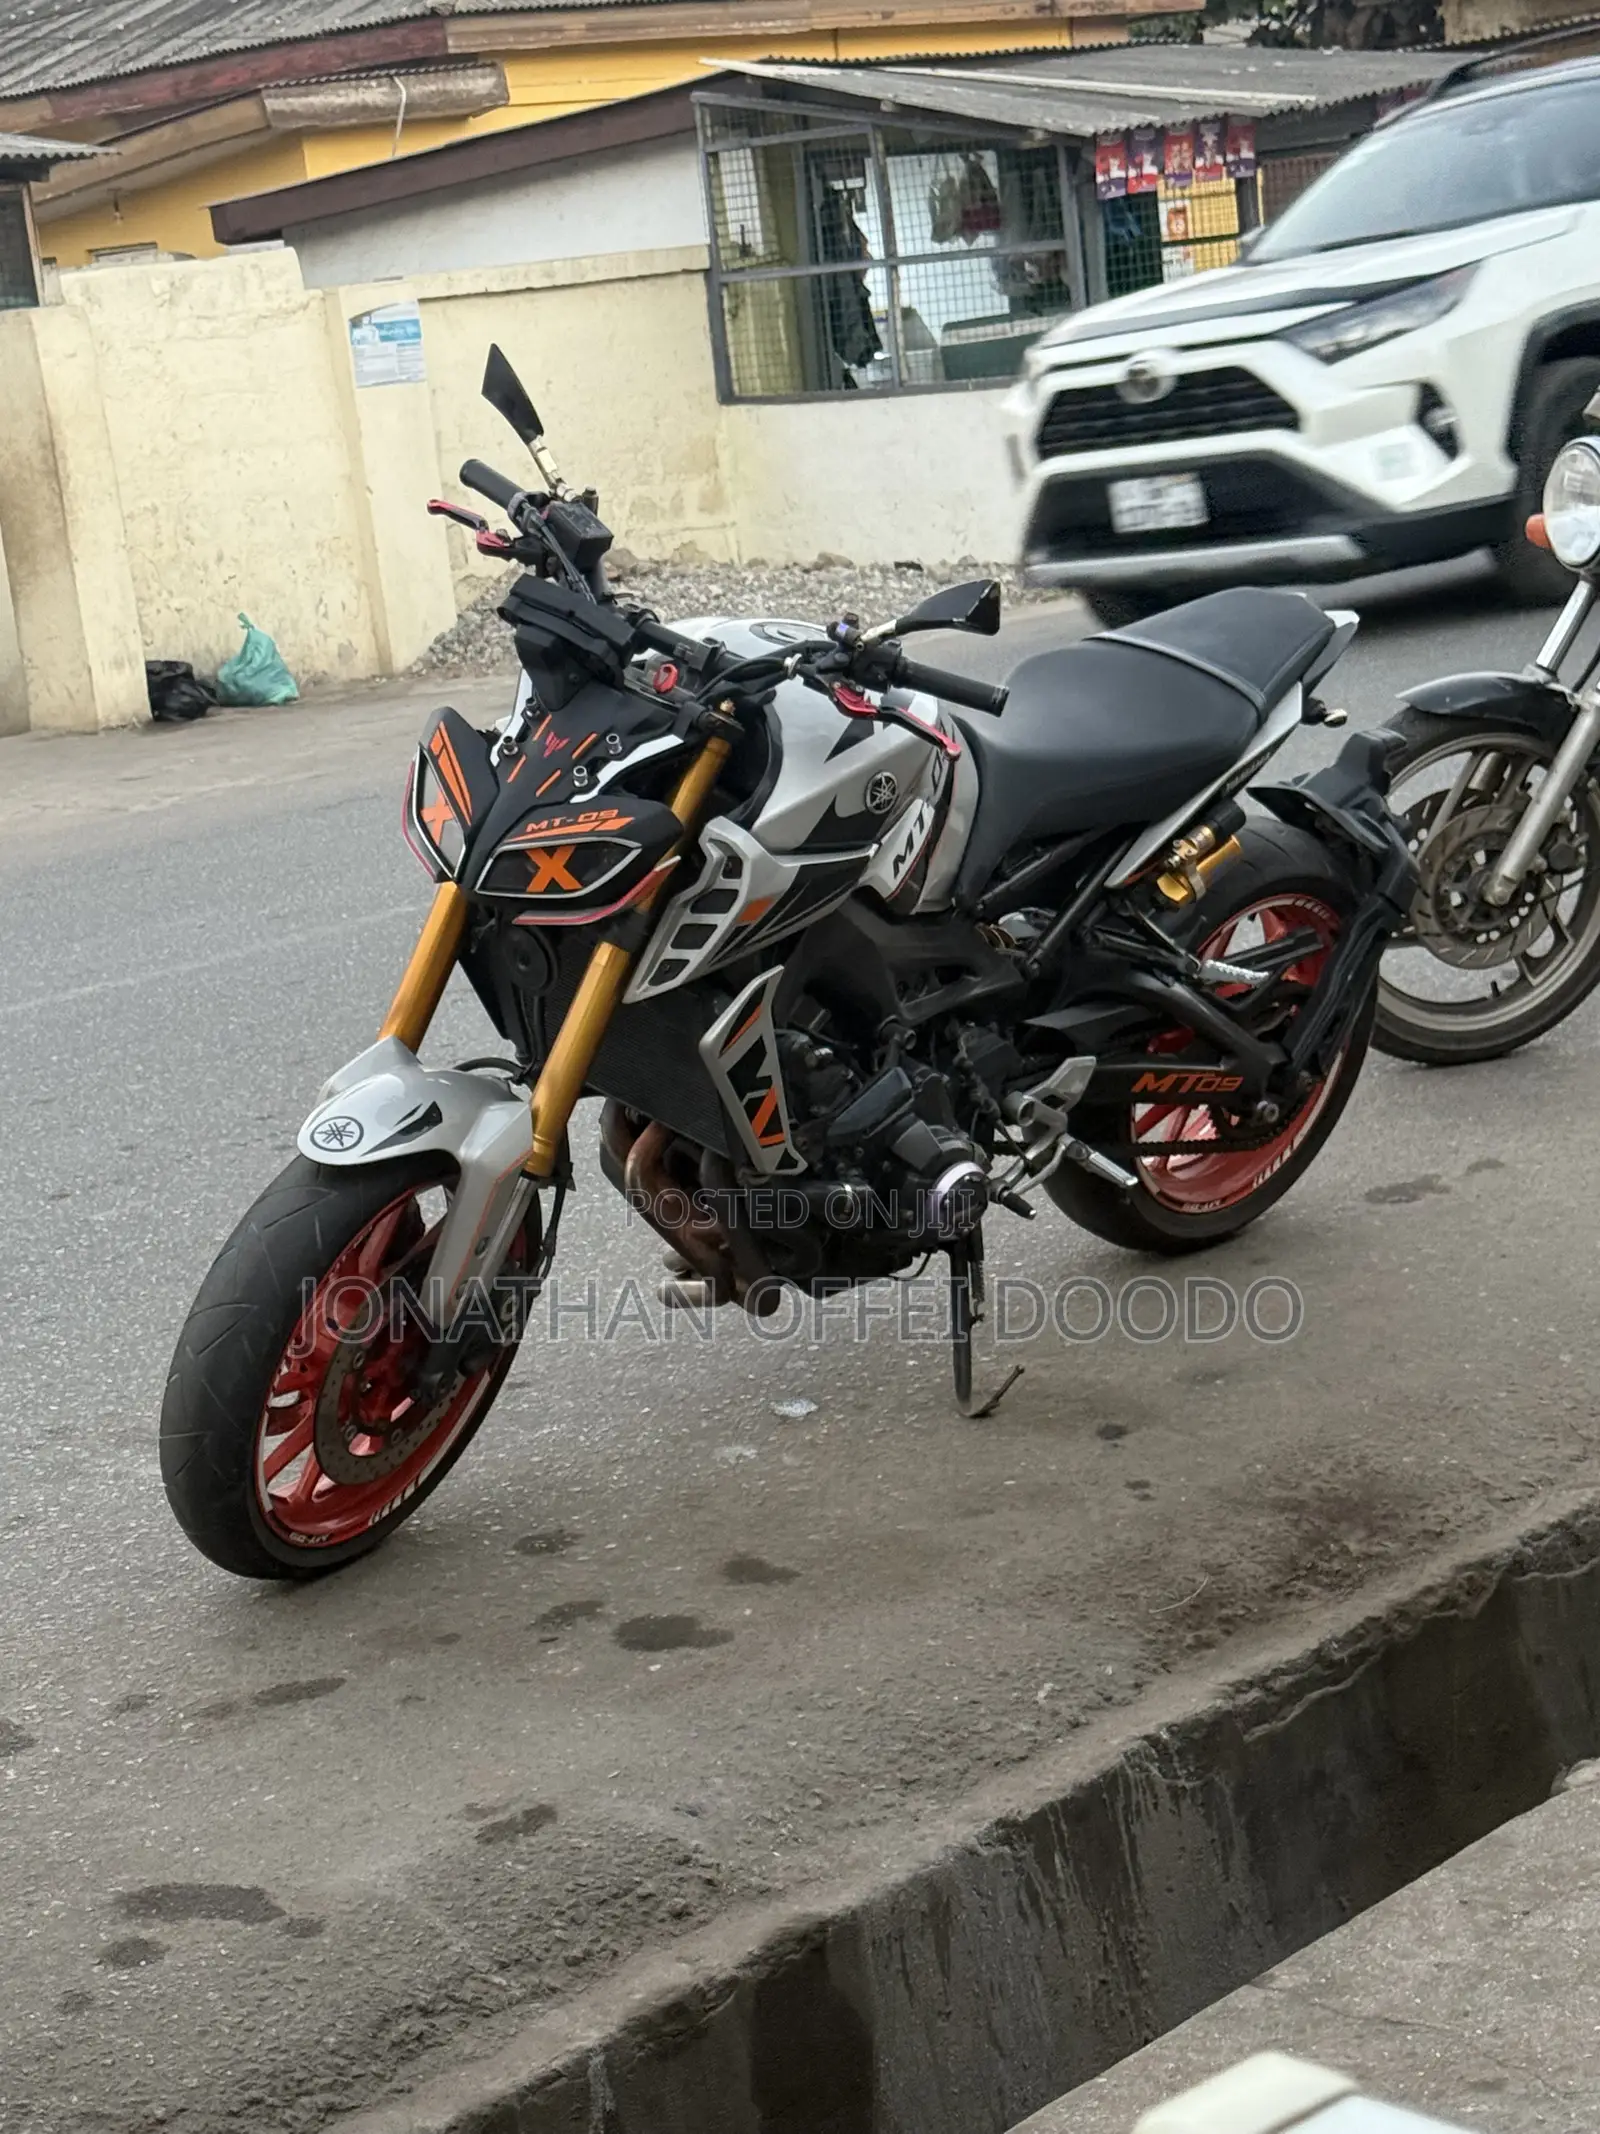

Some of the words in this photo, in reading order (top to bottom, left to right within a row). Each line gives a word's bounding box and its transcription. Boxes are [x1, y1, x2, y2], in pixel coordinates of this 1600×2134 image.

[420, 790, 454, 847] X
[525, 808, 620, 833] MT-09
[525, 845, 583, 893] X
